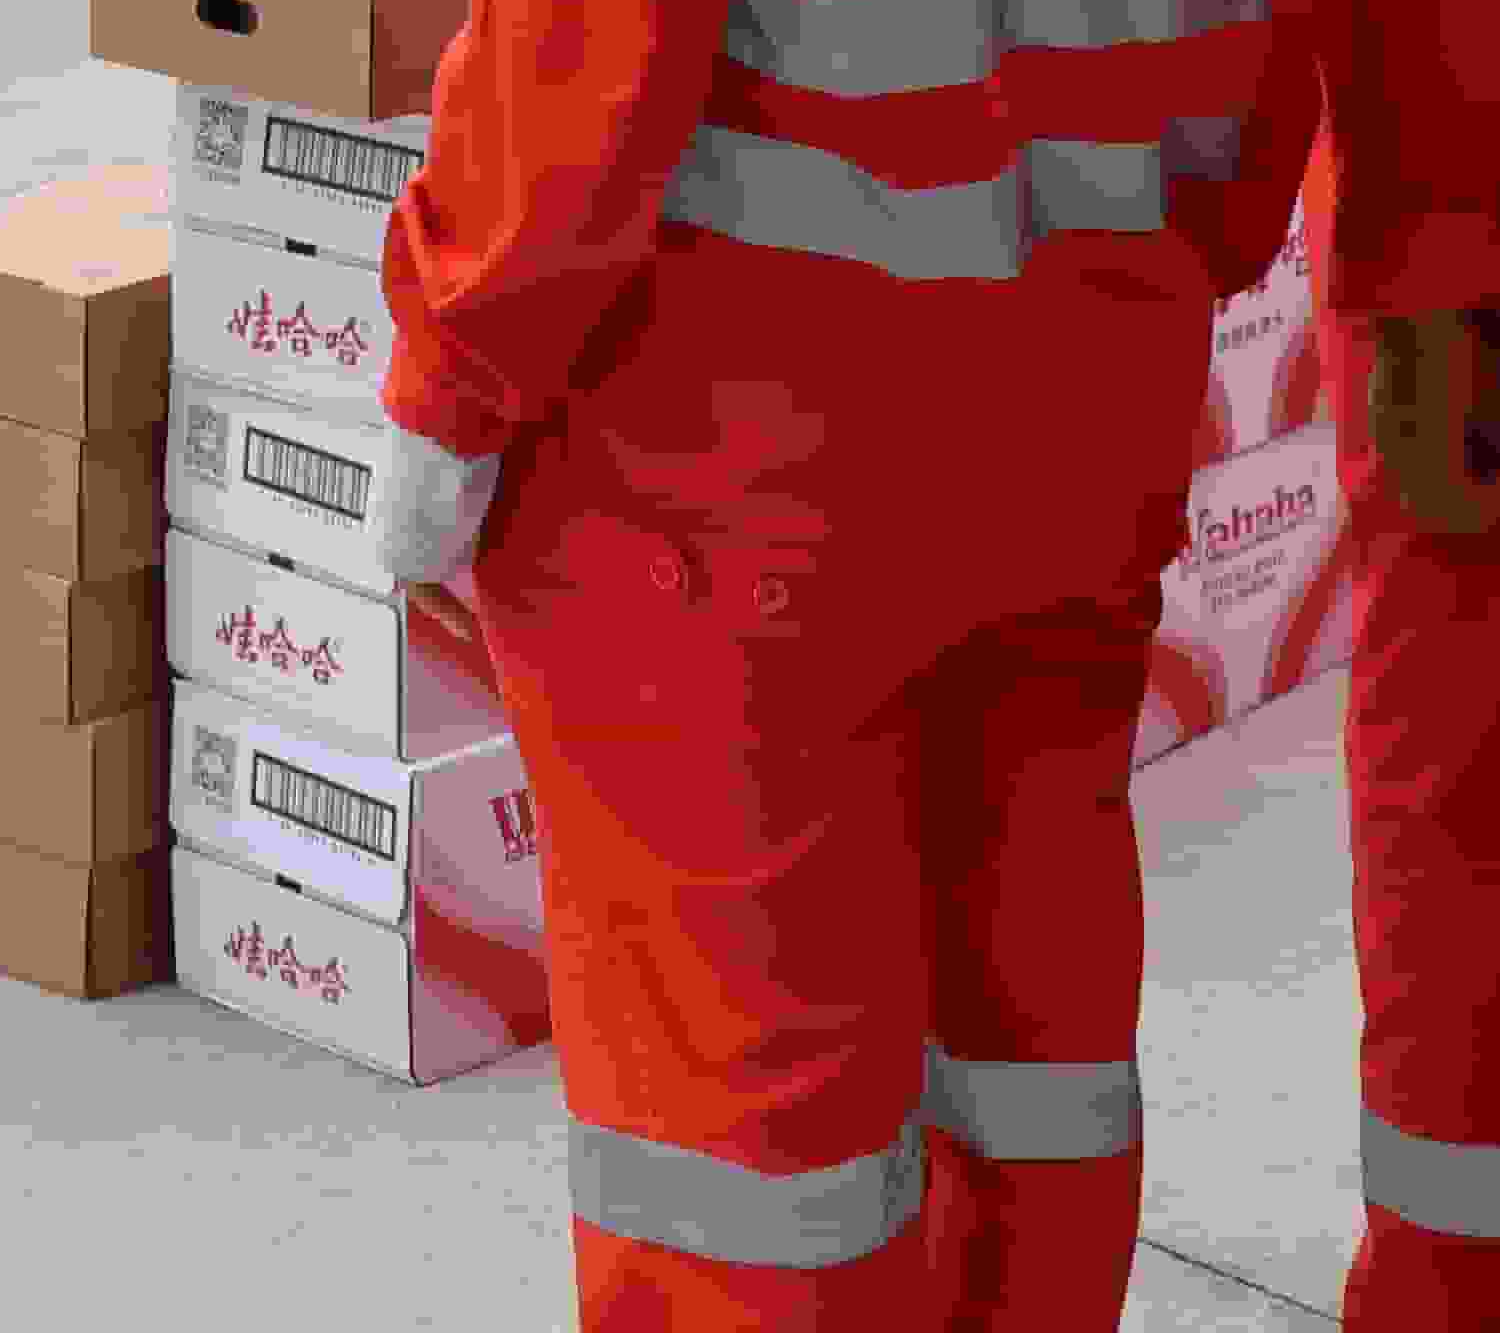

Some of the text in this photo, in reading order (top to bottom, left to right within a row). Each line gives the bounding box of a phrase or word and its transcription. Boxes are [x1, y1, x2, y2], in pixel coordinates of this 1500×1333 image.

[224, 287, 370, 367] 娃哈哈
[214, 605, 342, 685] 娃哈哈
[223, 917, 351, 1006] 娃哈哈
